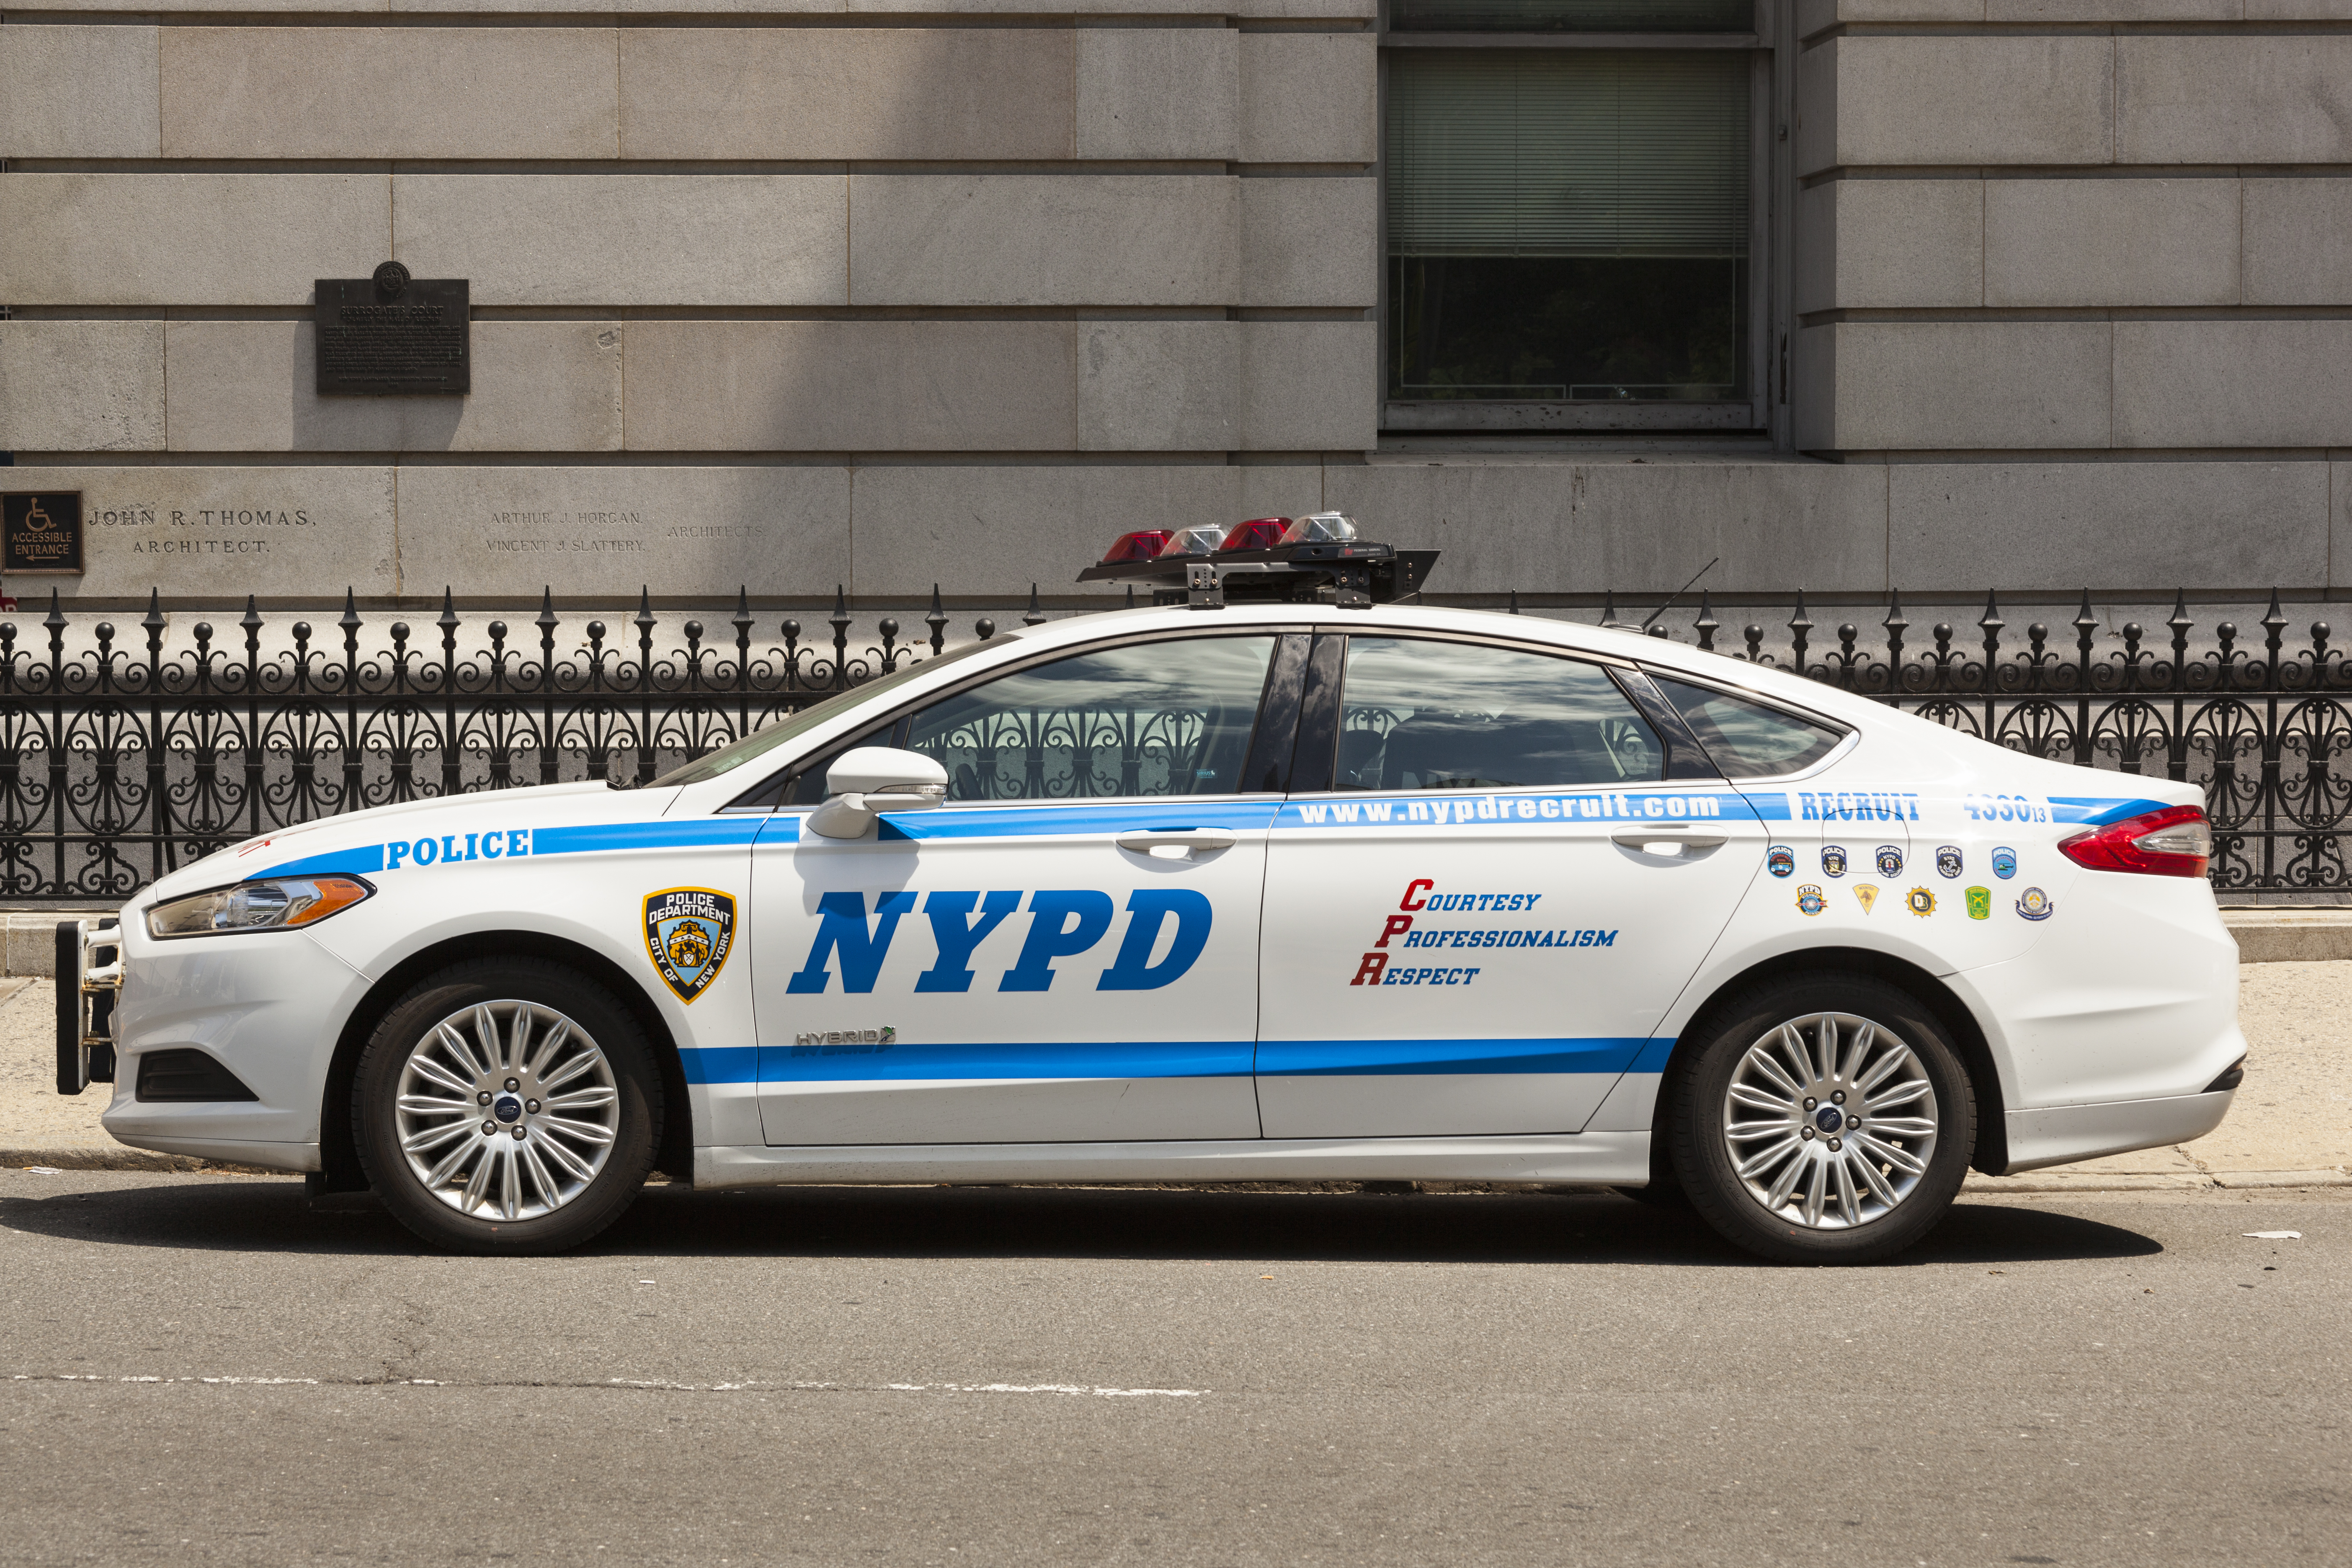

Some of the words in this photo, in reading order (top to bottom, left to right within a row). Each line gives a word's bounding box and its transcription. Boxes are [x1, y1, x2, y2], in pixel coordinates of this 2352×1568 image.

[341, 306, 405, 315] SURROGATE'S
[411, 306, 444, 315] COURT
[89, 510, 155, 526] JOHN
[490, 512, 550, 524] ARTHUR
[12, 532, 72, 543] ACCESSIBLE
[15, 544, 69, 555] ENTRANCE
[133, 540, 271, 554] ARCHITECT.
[486, 540, 549, 552] VINCENT
[1298, 794, 1720, 825] www.nypdrecruit.com
[1798, 792, 1919, 821] RECRUIT
[1963, 794, 2031, 822] 4330
[2032, 806, 2046, 823] 13
[387, 829, 529, 870] POLICE
[1769, 846, 1792, 856] POLICE
[1823, 847, 1845, 857] POLICE
[1877, 846, 1901, 856] POLICE
[1938, 847, 1961, 858] POLICE
[1994, 848, 2015, 858] POLICE
[1938, 865, 1954, 877] HARBOR
[1399, 878, 1542, 912] COURTESY
[1798, 885, 1821, 896] NYPD
[666, 893, 714, 907] POLICE
[649, 904, 730, 926] DEPARTMENT
[1374, 915, 1619, 948] PROFESSIONALISM
[785, 888, 1213, 994] NYPD
[650, 937, 667, 965] CITY
[664, 968, 678, 983] OF
[695, 964, 715, 989] NEW
[713, 931, 730, 961] YORK
[1349, 952, 1480, 986] RESPECT
[797, 1028, 879, 1045] HYBRID
[1823, 1115, 1834, 1127] Ford
